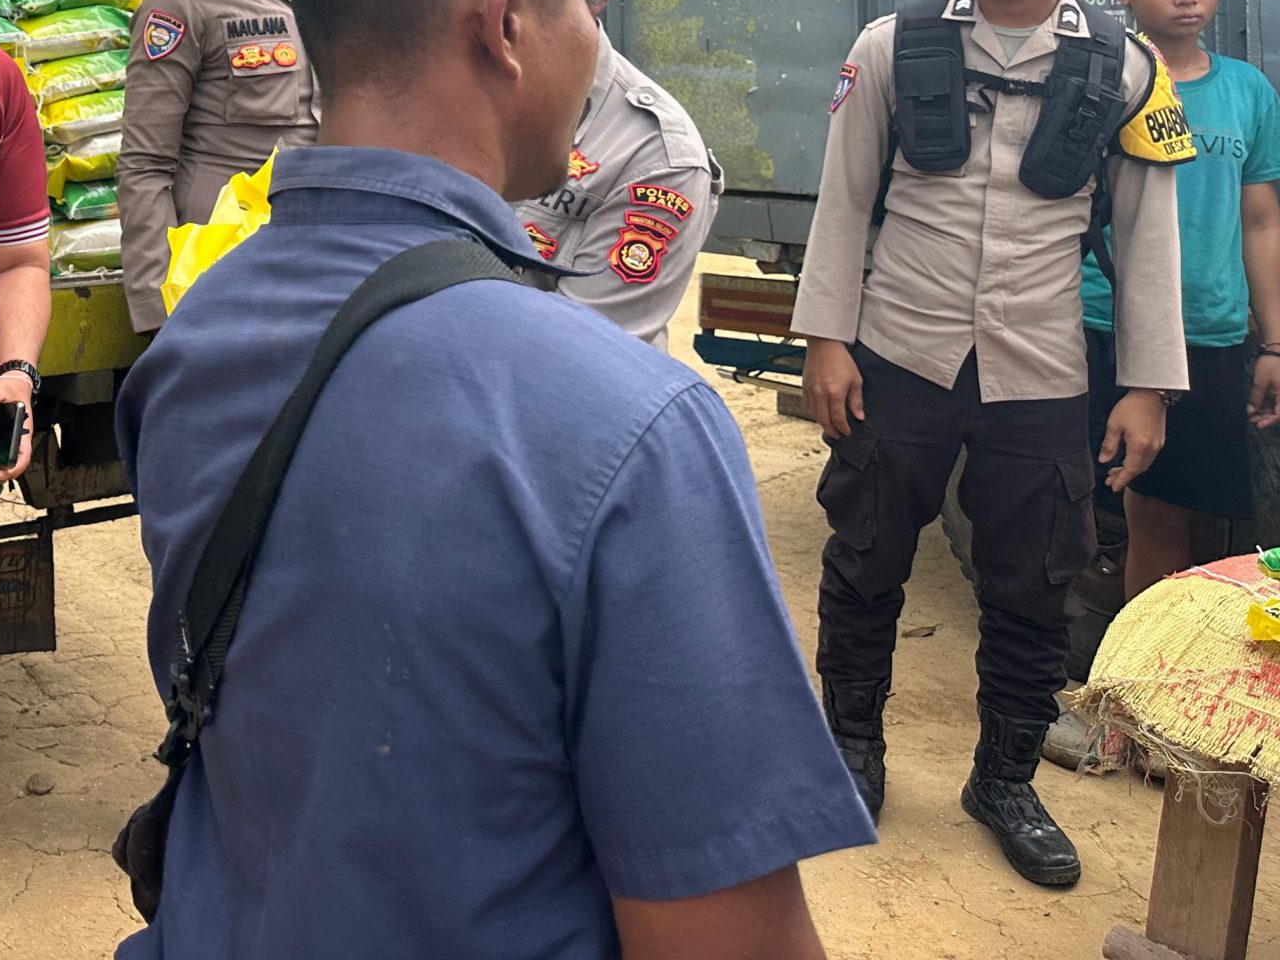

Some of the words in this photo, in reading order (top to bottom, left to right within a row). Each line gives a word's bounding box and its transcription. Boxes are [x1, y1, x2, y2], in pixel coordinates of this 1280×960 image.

[226, 17, 288, 39] MAULANA
[636, 187, 689, 212] POLRES
[648, 196, 679, 211] PALI
